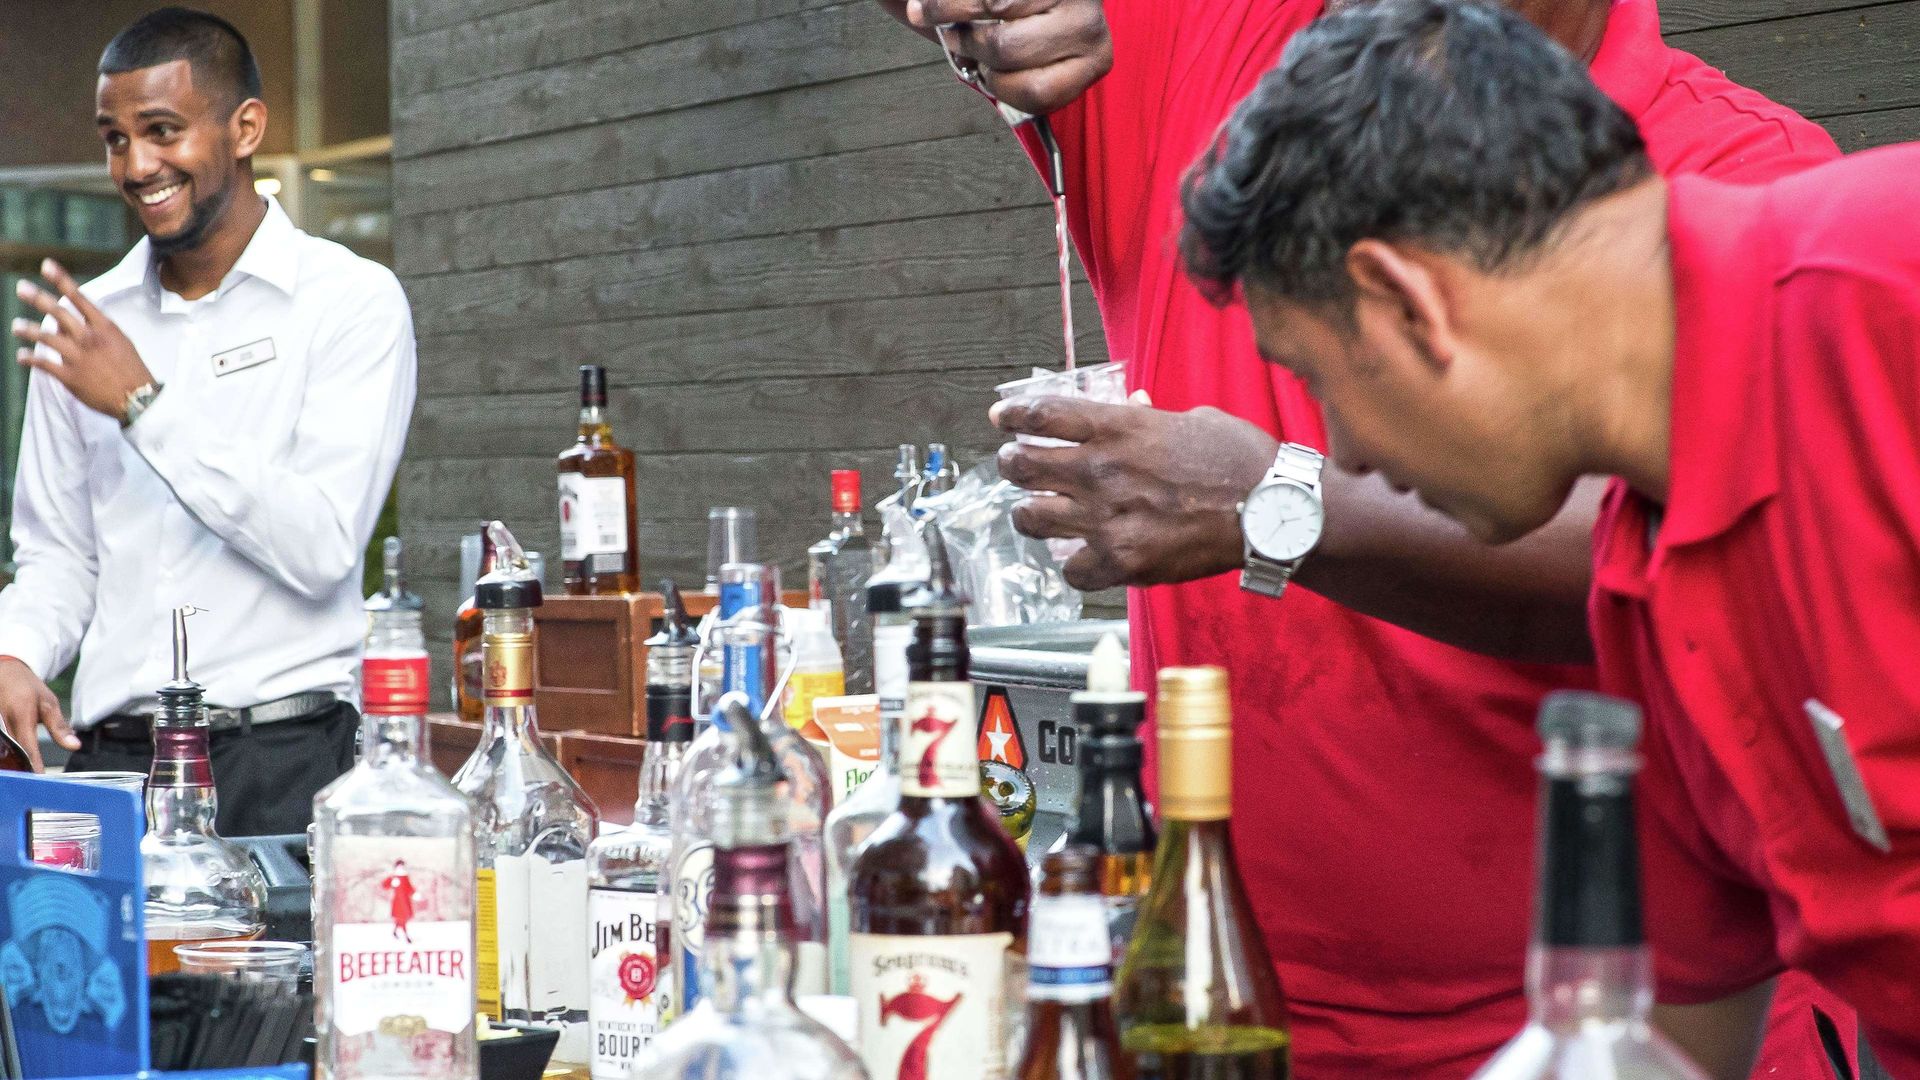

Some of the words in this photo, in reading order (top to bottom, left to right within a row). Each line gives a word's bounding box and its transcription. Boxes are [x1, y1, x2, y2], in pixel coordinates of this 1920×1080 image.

[909, 704, 960, 789] 7
[339, 949, 465, 983] BEEFEATER
[591, 920, 623, 959] JIM
[877, 974, 966, 1080] 7
